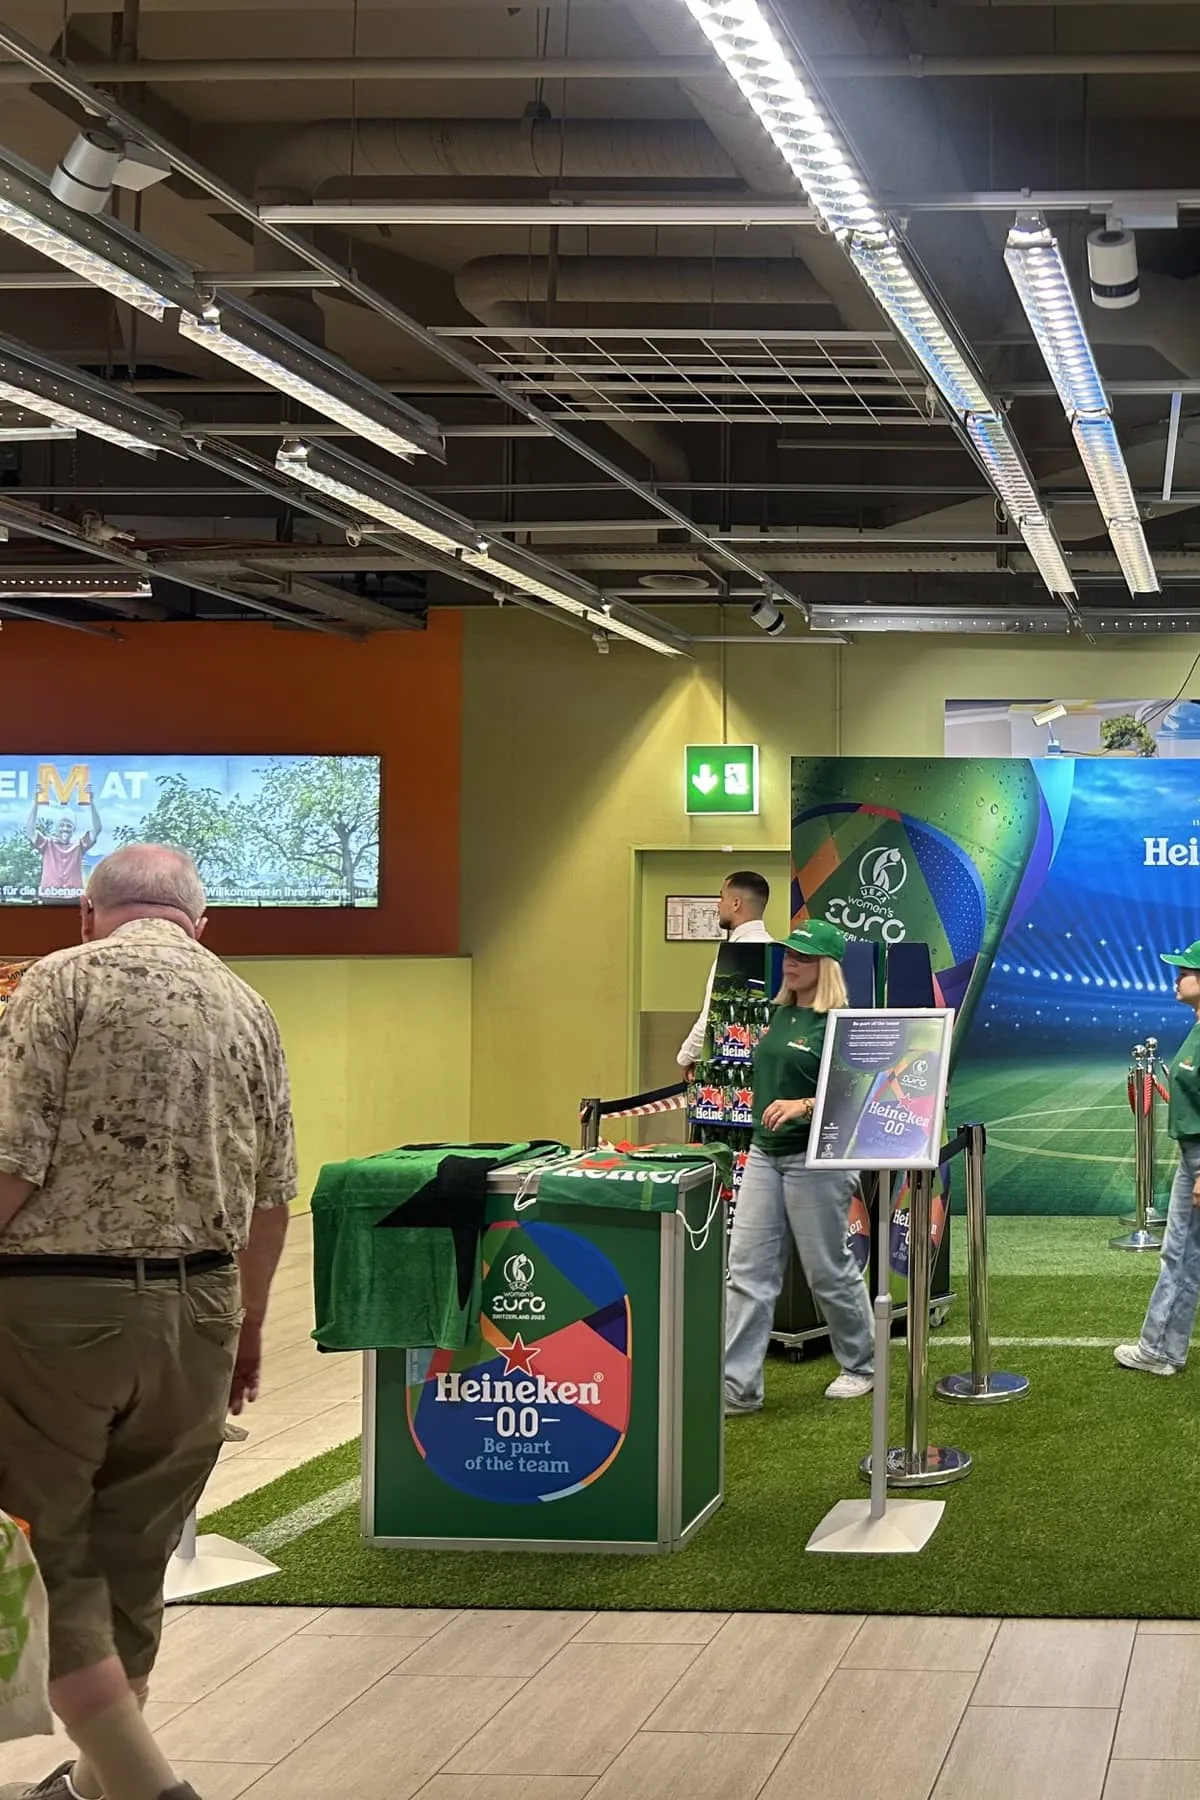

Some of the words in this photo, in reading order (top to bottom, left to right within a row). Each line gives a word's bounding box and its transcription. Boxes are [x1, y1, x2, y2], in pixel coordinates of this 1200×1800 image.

[2, 885, 18, 896] für
[20, 885, 36, 896] die
[205, 886, 270, 897] Willkommen
[272, 886, 282, 897] in
[284, 886, 309, 897] Ihrer
[860, 888, 888, 904] UEFA
[847, 895, 895, 919] women's
[722, 1045, 750, 1058] Heine
[696, 1107, 723, 1121] Heine
[867, 1100, 930, 1128] Heineken
[483, 1437, 506, 1453] Be
[510, 1439, 551, 1457] part
[465, 1456, 483, 1471] of
[486, 1456, 514, 1471] the
[519, 1458, 570, 1474] team
